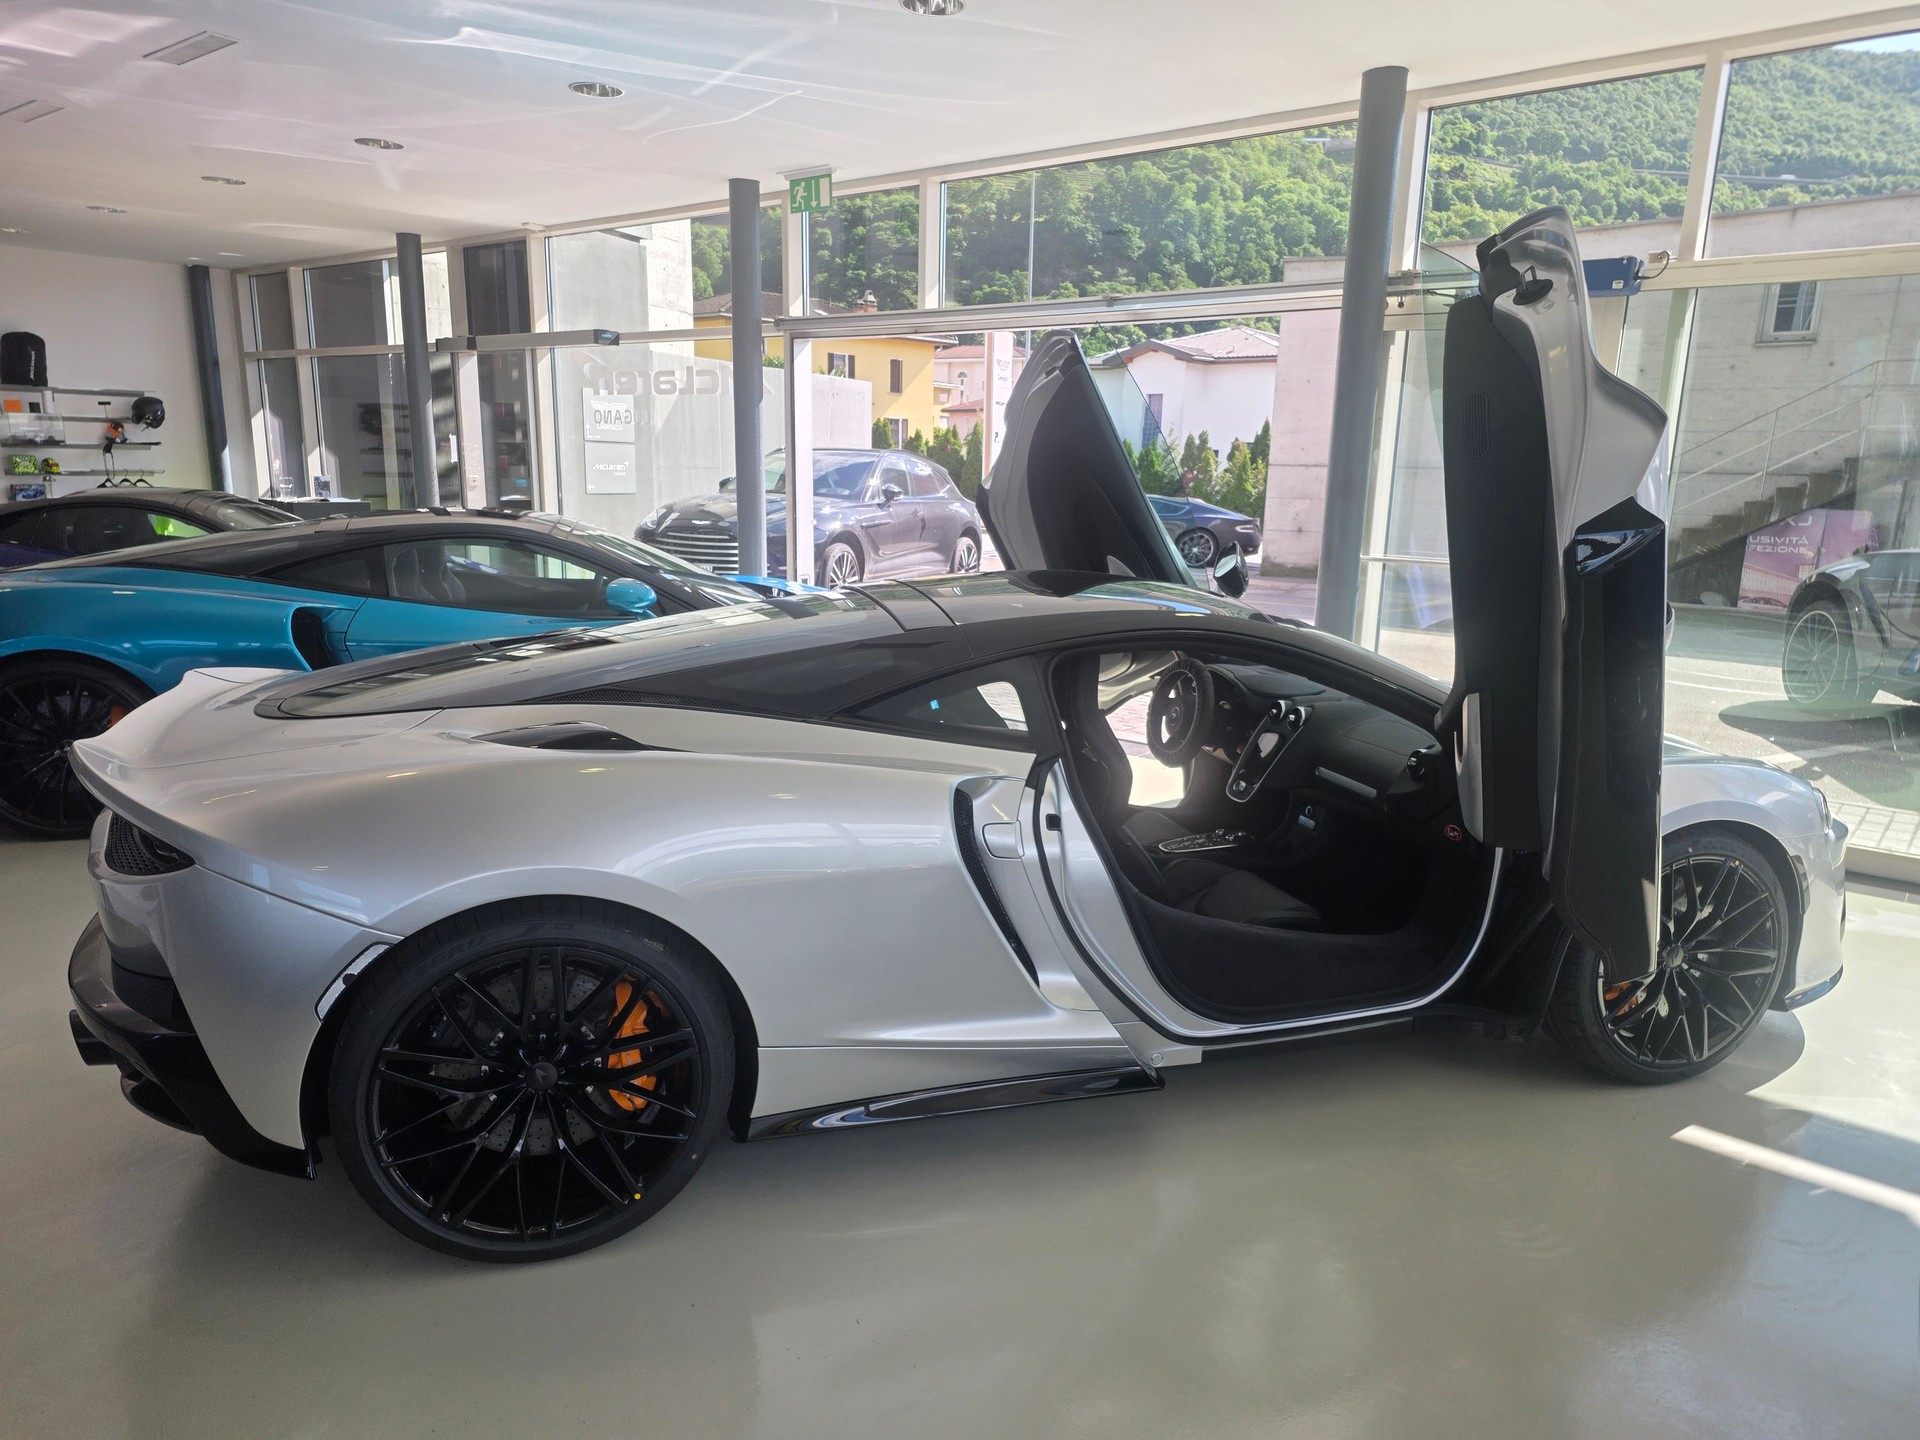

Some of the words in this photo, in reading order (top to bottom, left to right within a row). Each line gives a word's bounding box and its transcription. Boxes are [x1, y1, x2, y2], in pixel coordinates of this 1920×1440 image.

[593, 463, 627, 471] McLaren
[1747, 534, 1809, 545] USIVITÀ
[1745, 544, 1808, 554] FEZIONE
